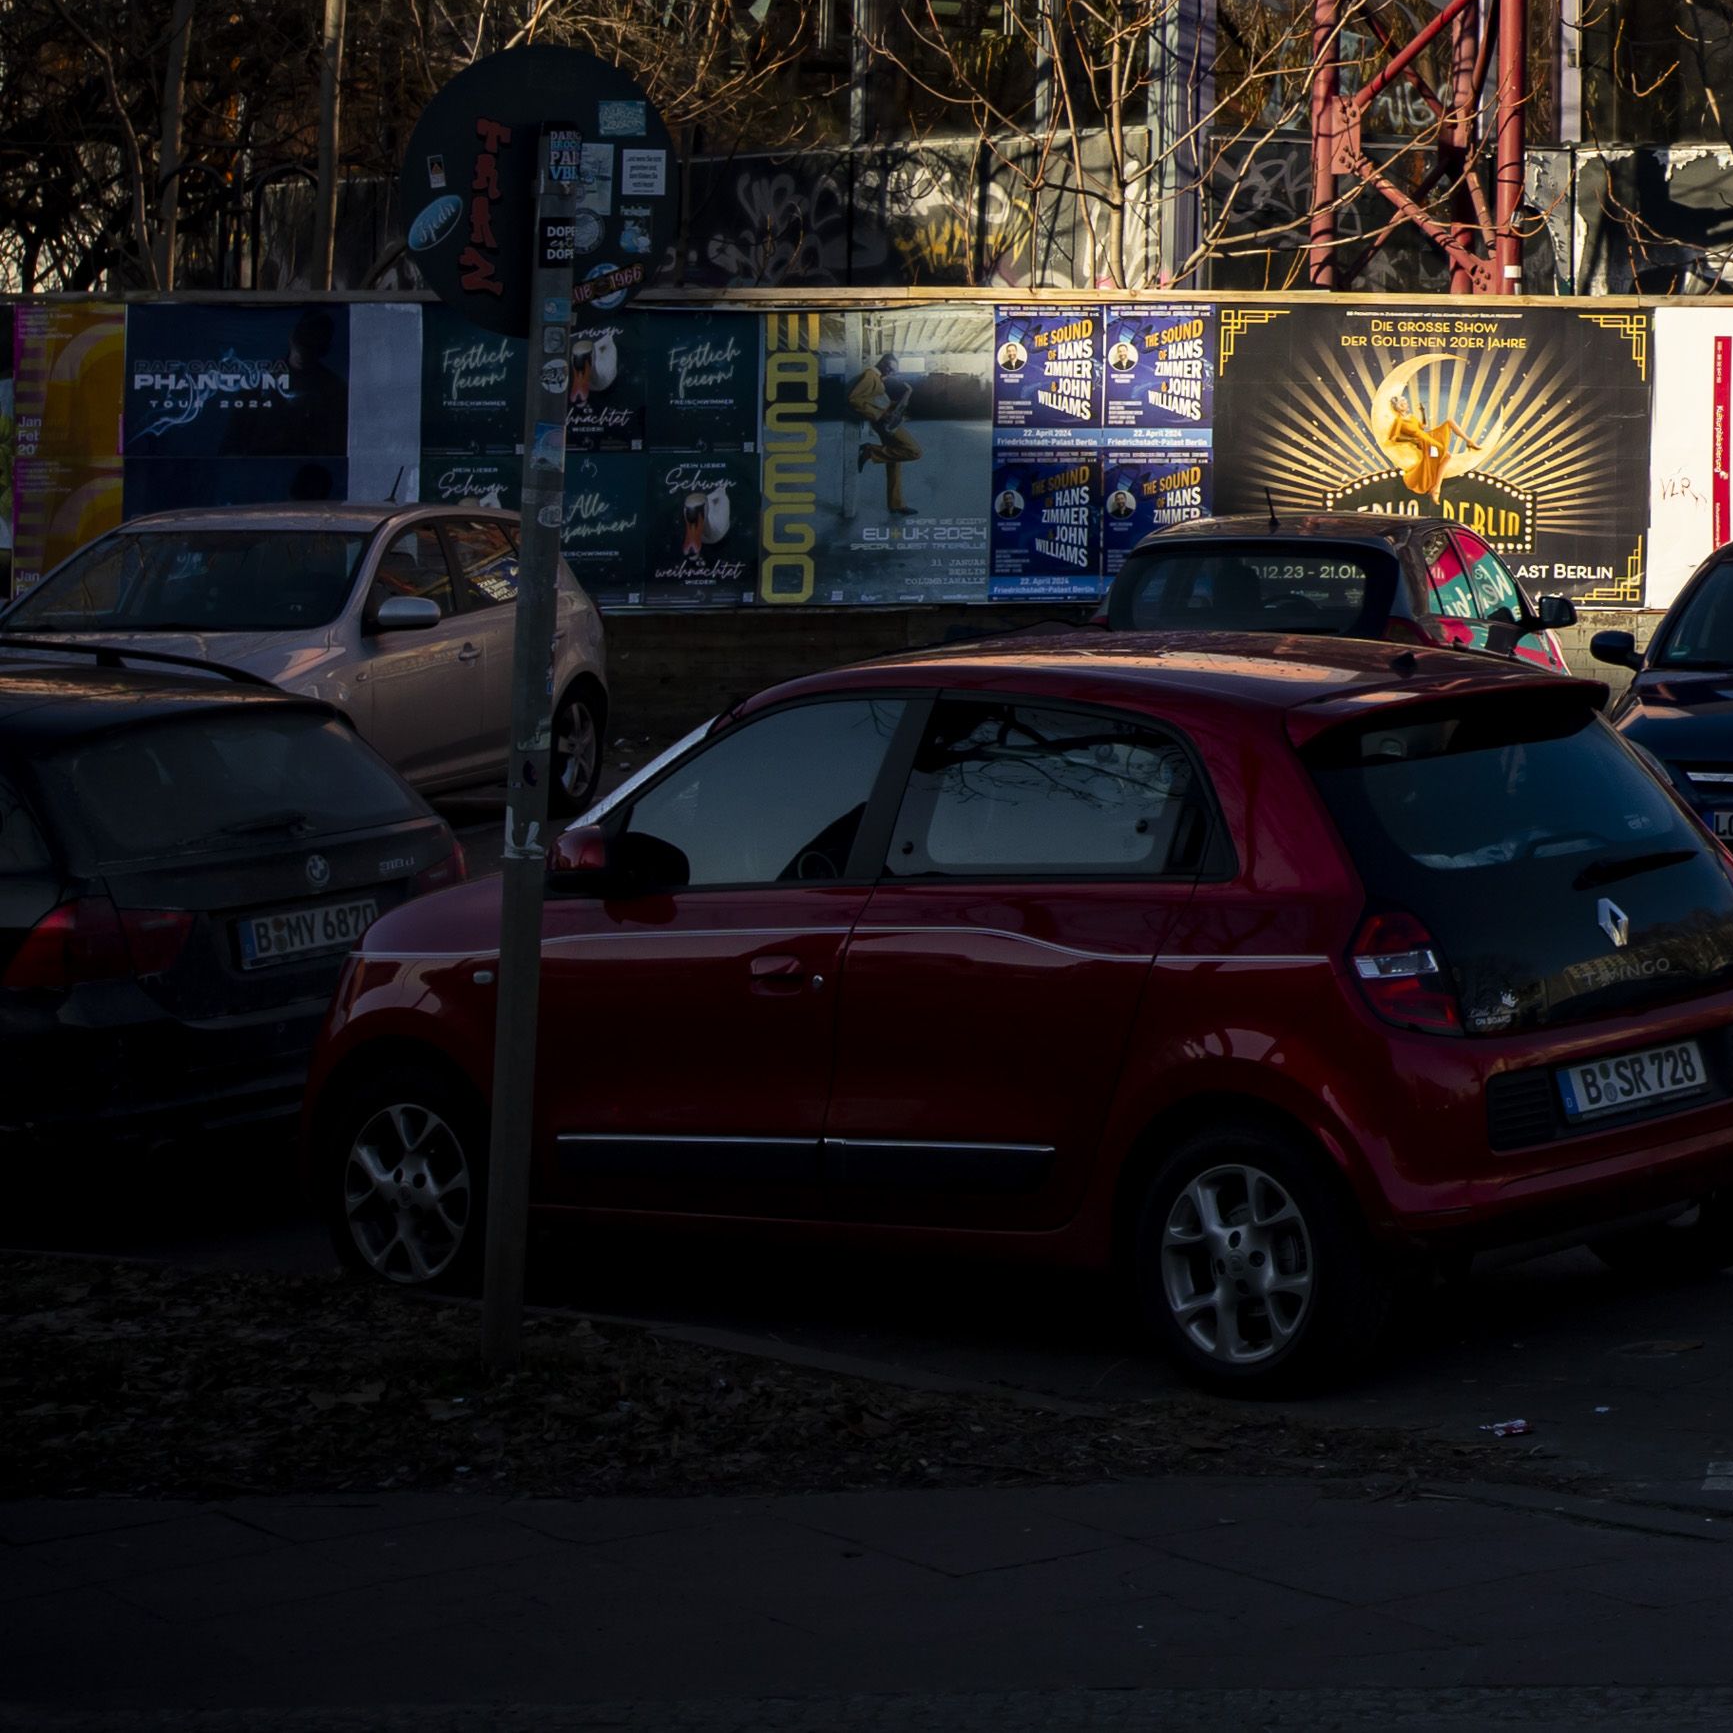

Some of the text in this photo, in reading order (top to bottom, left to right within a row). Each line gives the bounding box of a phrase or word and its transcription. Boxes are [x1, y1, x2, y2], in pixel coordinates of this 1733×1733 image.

[1034, 318, 1094, 348] THE SOUND
[1144, 318, 1204, 348] THE SOUND
[1371, 319, 1394, 332] DIE
[1454, 320, 1498, 333] SHOW
[1057, 339, 1094, 360] HANS
[1168, 339, 1204, 360] HANS
[1341, 335, 1367, 347] DER
[1371, 334, 1446, 348] GOLDENEN
[1487, 335, 1527, 351] JAHRE
[1044, 359, 1093, 379] ZIMMER
[1154, 359, 1203, 379] ZIMMER
[1057, 377, 1092, 400] JOHN
[1168, 377, 1202, 400] JOHN
[149, 400, 273, 409] TOUR 2024
[1037, 389, 1092, 421] WILLIAMS
[1148, 389, 1202, 421] WILLIAMS
[1048, 465, 1090, 492] SOUND
[1143, 466, 1202, 496] THE SOUND
[1055, 486, 1090, 507] HANS
[1166, 486, 1202, 507] HANS
[1041, 507, 1089, 526] ZIMMER
[933, 527, 988, 540] 2024
[1055, 526, 1088, 547] JOHN
[1034, 537, 1088, 568] WILLIAMS
[1553, 563, 1613, 579] BERLIN
[254, 919, 273, 953] B
[286, 914, 317, 949] MY
[1583, 957, 1671, 988] TWINGO
[1580, 1046, 1698, 1104] B SR 728
